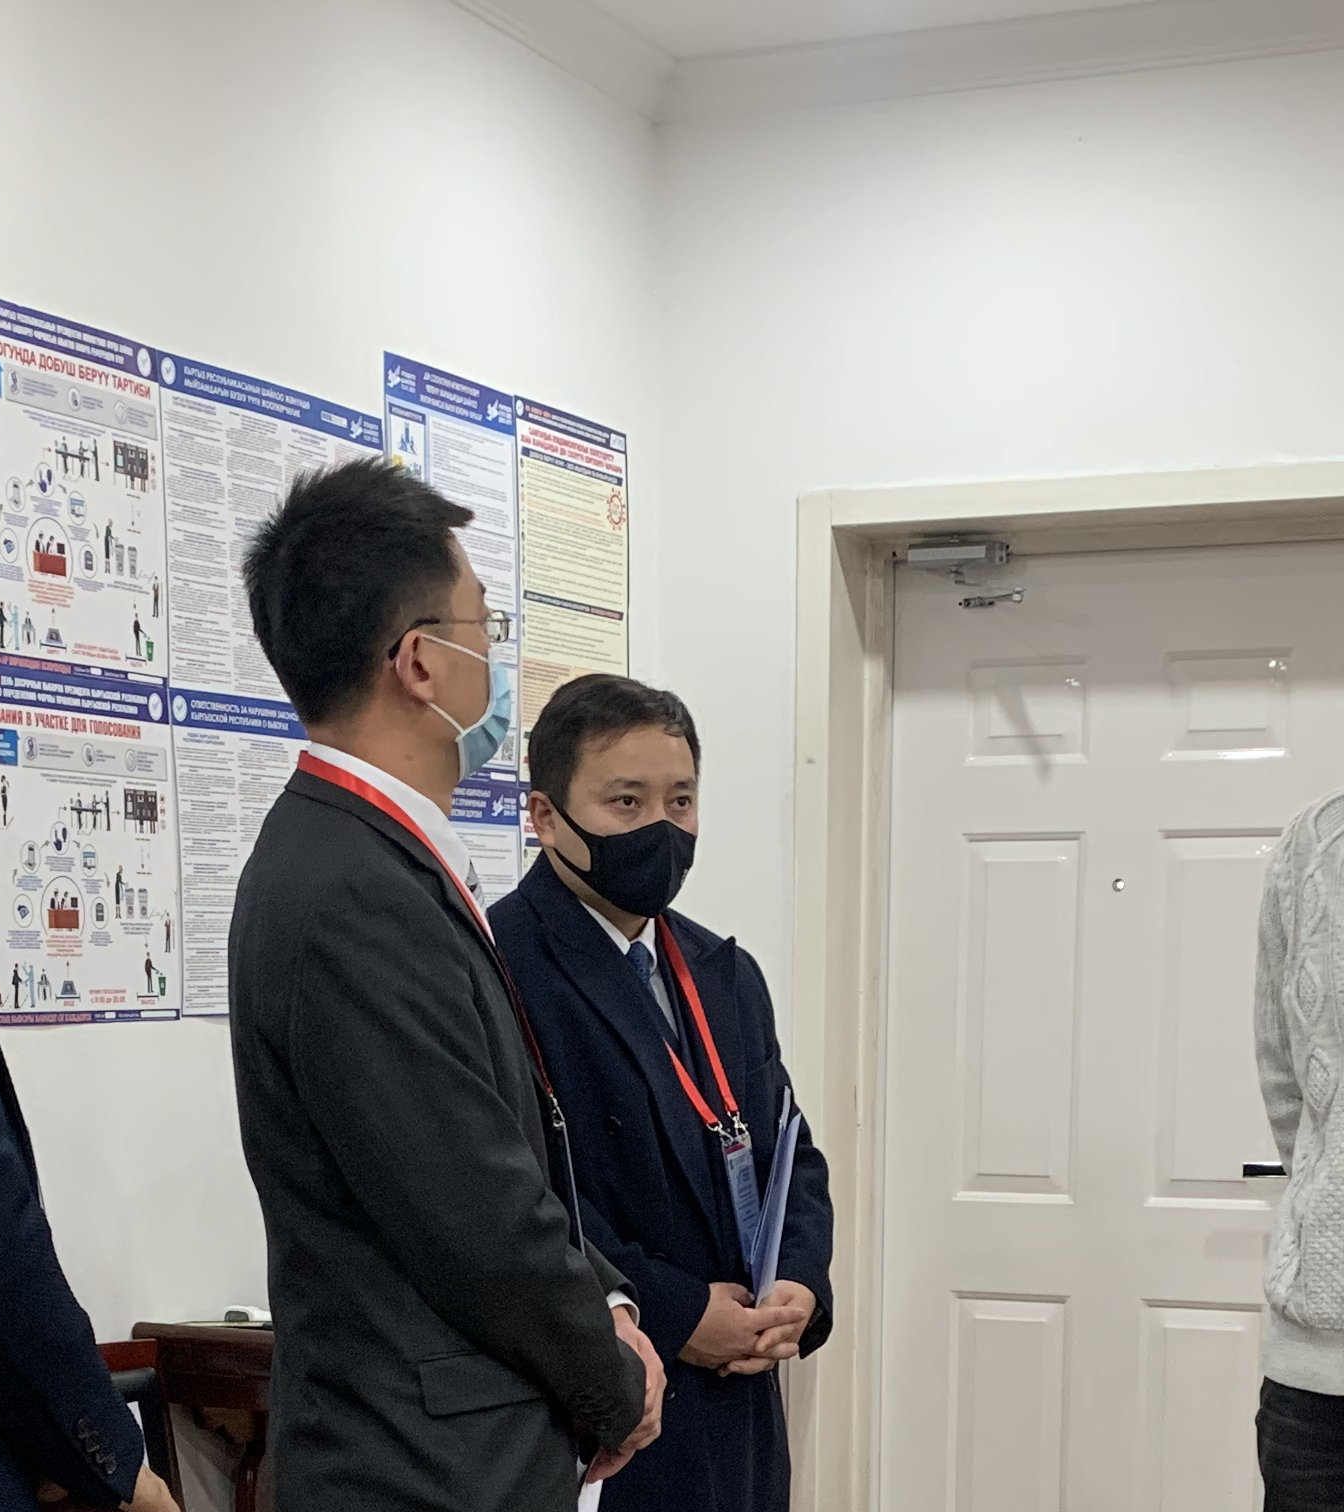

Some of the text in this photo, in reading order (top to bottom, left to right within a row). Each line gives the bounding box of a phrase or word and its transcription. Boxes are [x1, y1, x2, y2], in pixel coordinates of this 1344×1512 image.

[39, 352, 76, 378] ДОБУШ
[78, 365, 109, 387] БЕРҮҮ
[112, 374, 151, 400] ТАРТИБИ
[26, 711, 32, 726] В
[35, 712, 69, 731] УЧАСТКЕ
[71, 716, 87, 734] ДЛЯ
[89, 718, 141, 739] ГОЛОСОВАНИЯ
